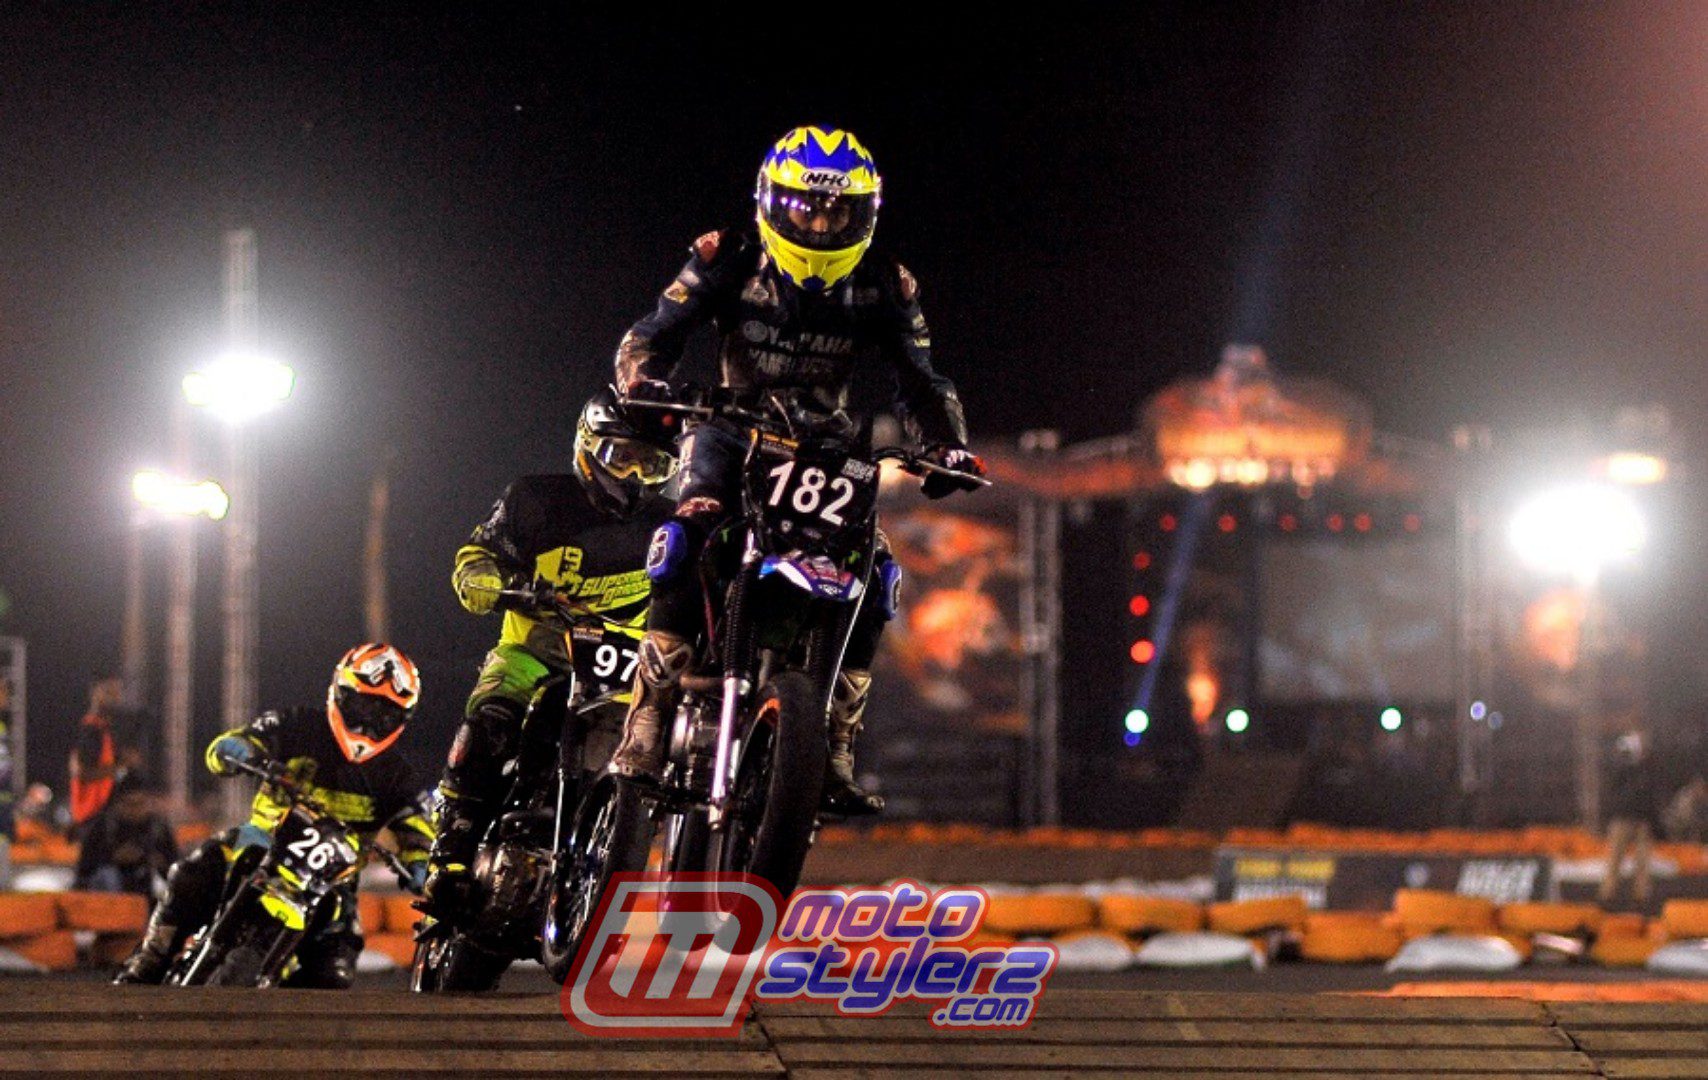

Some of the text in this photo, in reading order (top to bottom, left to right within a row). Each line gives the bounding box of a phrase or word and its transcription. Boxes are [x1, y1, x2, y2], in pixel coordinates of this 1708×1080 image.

[806, 172, 846, 187] NHK
[768, 325, 853, 354] YAHA
[767, 460, 855, 526] 182
[592, 644, 640, 683] 97
[286, 827, 335, 871] 26
